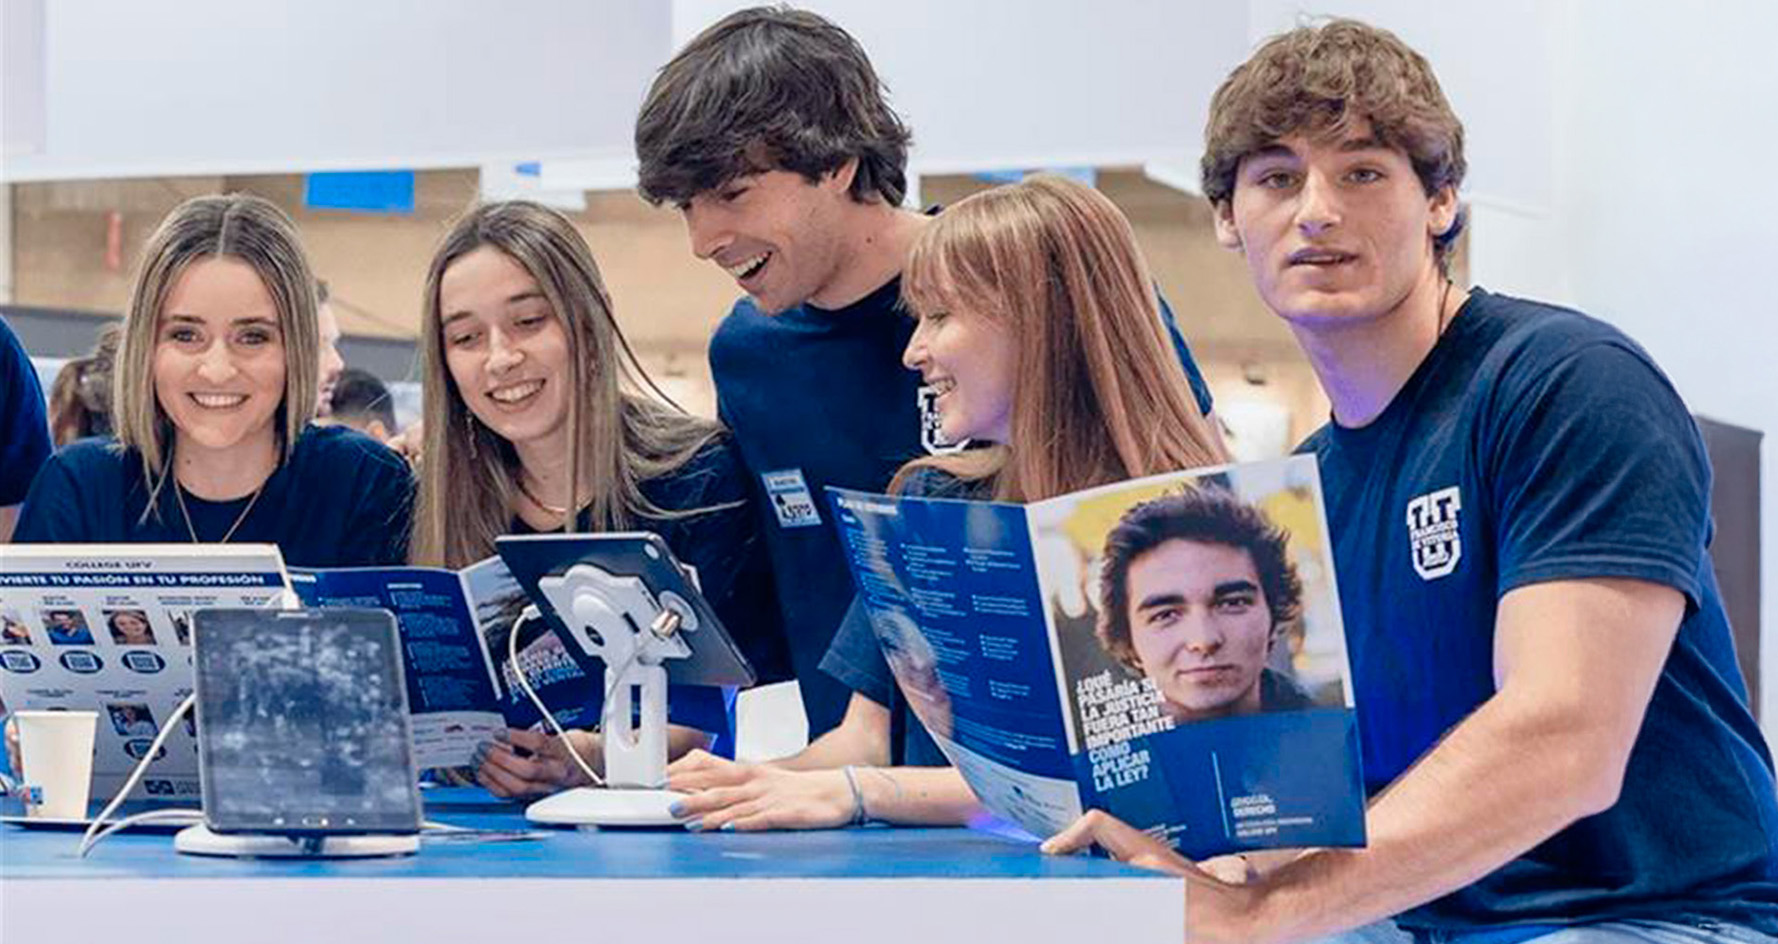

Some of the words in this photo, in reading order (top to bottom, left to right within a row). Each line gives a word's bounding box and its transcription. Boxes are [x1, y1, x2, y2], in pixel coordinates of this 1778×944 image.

[50, 575, 70, 585] TU
[73, 574, 130, 585] PASIÓN
[133, 576, 155, 585] EN
[157, 576, 177, 585] TU
[180, 574, 265, 585] PROFESIÓN
[66, 561, 121, 569] COLLEGE
[1080, 704, 1100, 721] LA
[1102, 690, 1167, 717] JUSTICIA
[1083, 715, 1131, 736] FUERA
[1131, 706, 1160, 724] TAN
[1086, 715, 1176, 750] IMPORTANTE
[1092, 750, 1151, 779] APLICAR
[1094, 774, 1114, 792] LA
[1115, 764, 1149, 787] LEY?
